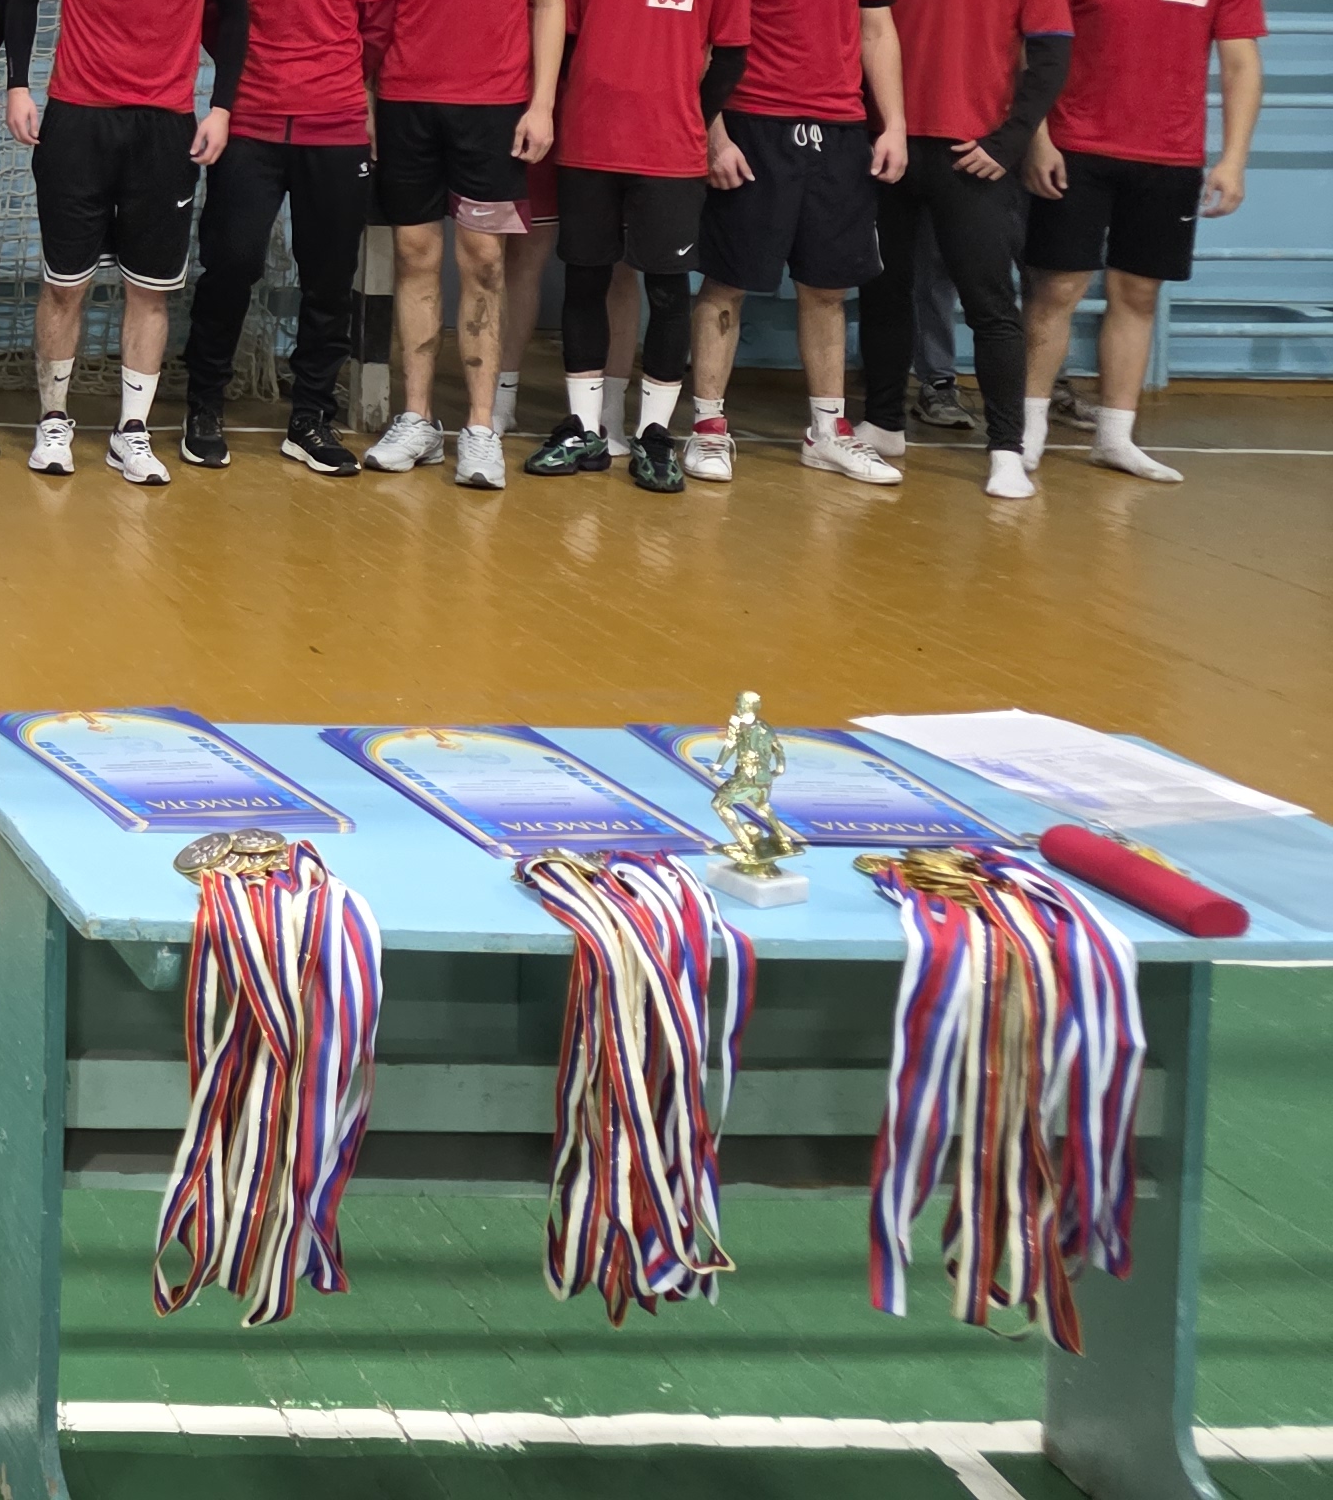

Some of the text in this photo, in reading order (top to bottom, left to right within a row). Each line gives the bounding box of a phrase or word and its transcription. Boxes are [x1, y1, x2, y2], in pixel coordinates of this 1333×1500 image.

[146, 797, 283, 811] ГРАМОТА
[500, 820, 645, 832] ГРАМОТА
[811, 821, 965, 834] ГРАМОТА
